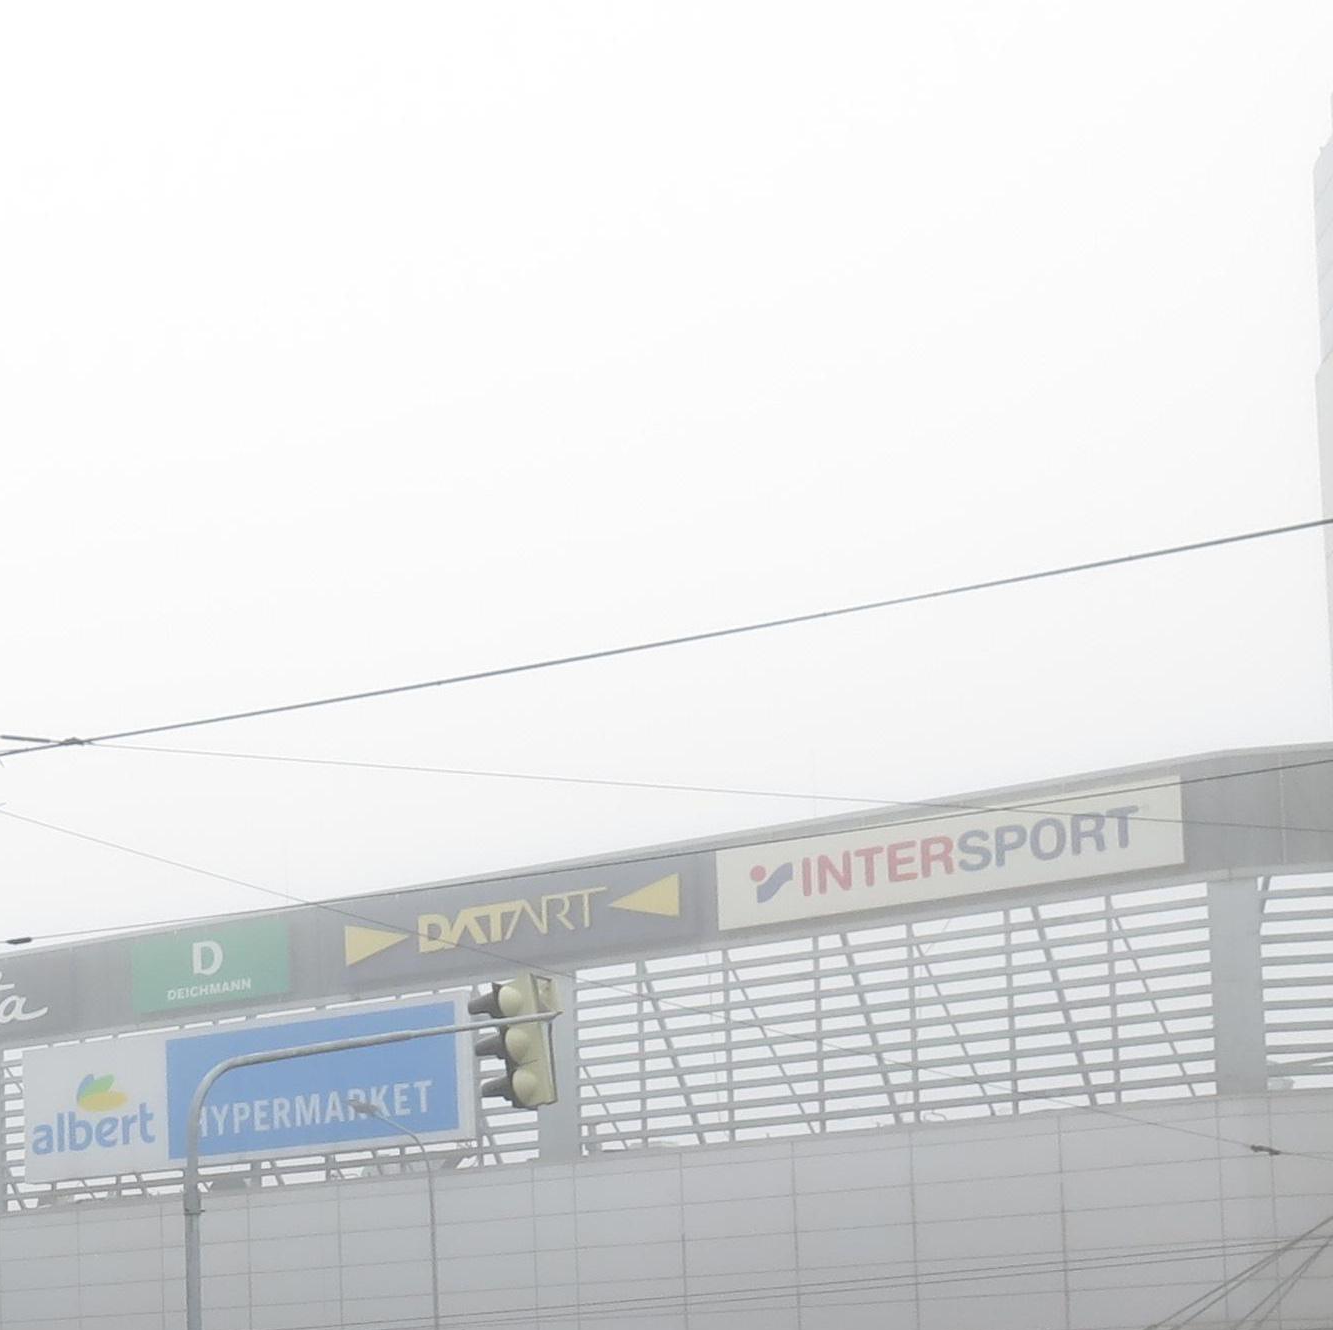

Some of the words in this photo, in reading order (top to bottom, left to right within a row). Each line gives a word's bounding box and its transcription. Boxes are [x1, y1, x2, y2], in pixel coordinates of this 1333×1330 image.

[801, 804, 1138, 897] INTERSPORT
[417, 886, 609, 953] DATART
[191, 940, 223, 976] D
[166, 977, 252, 1001] DEICHMANN
[33, 1102, 156, 1157] albert
